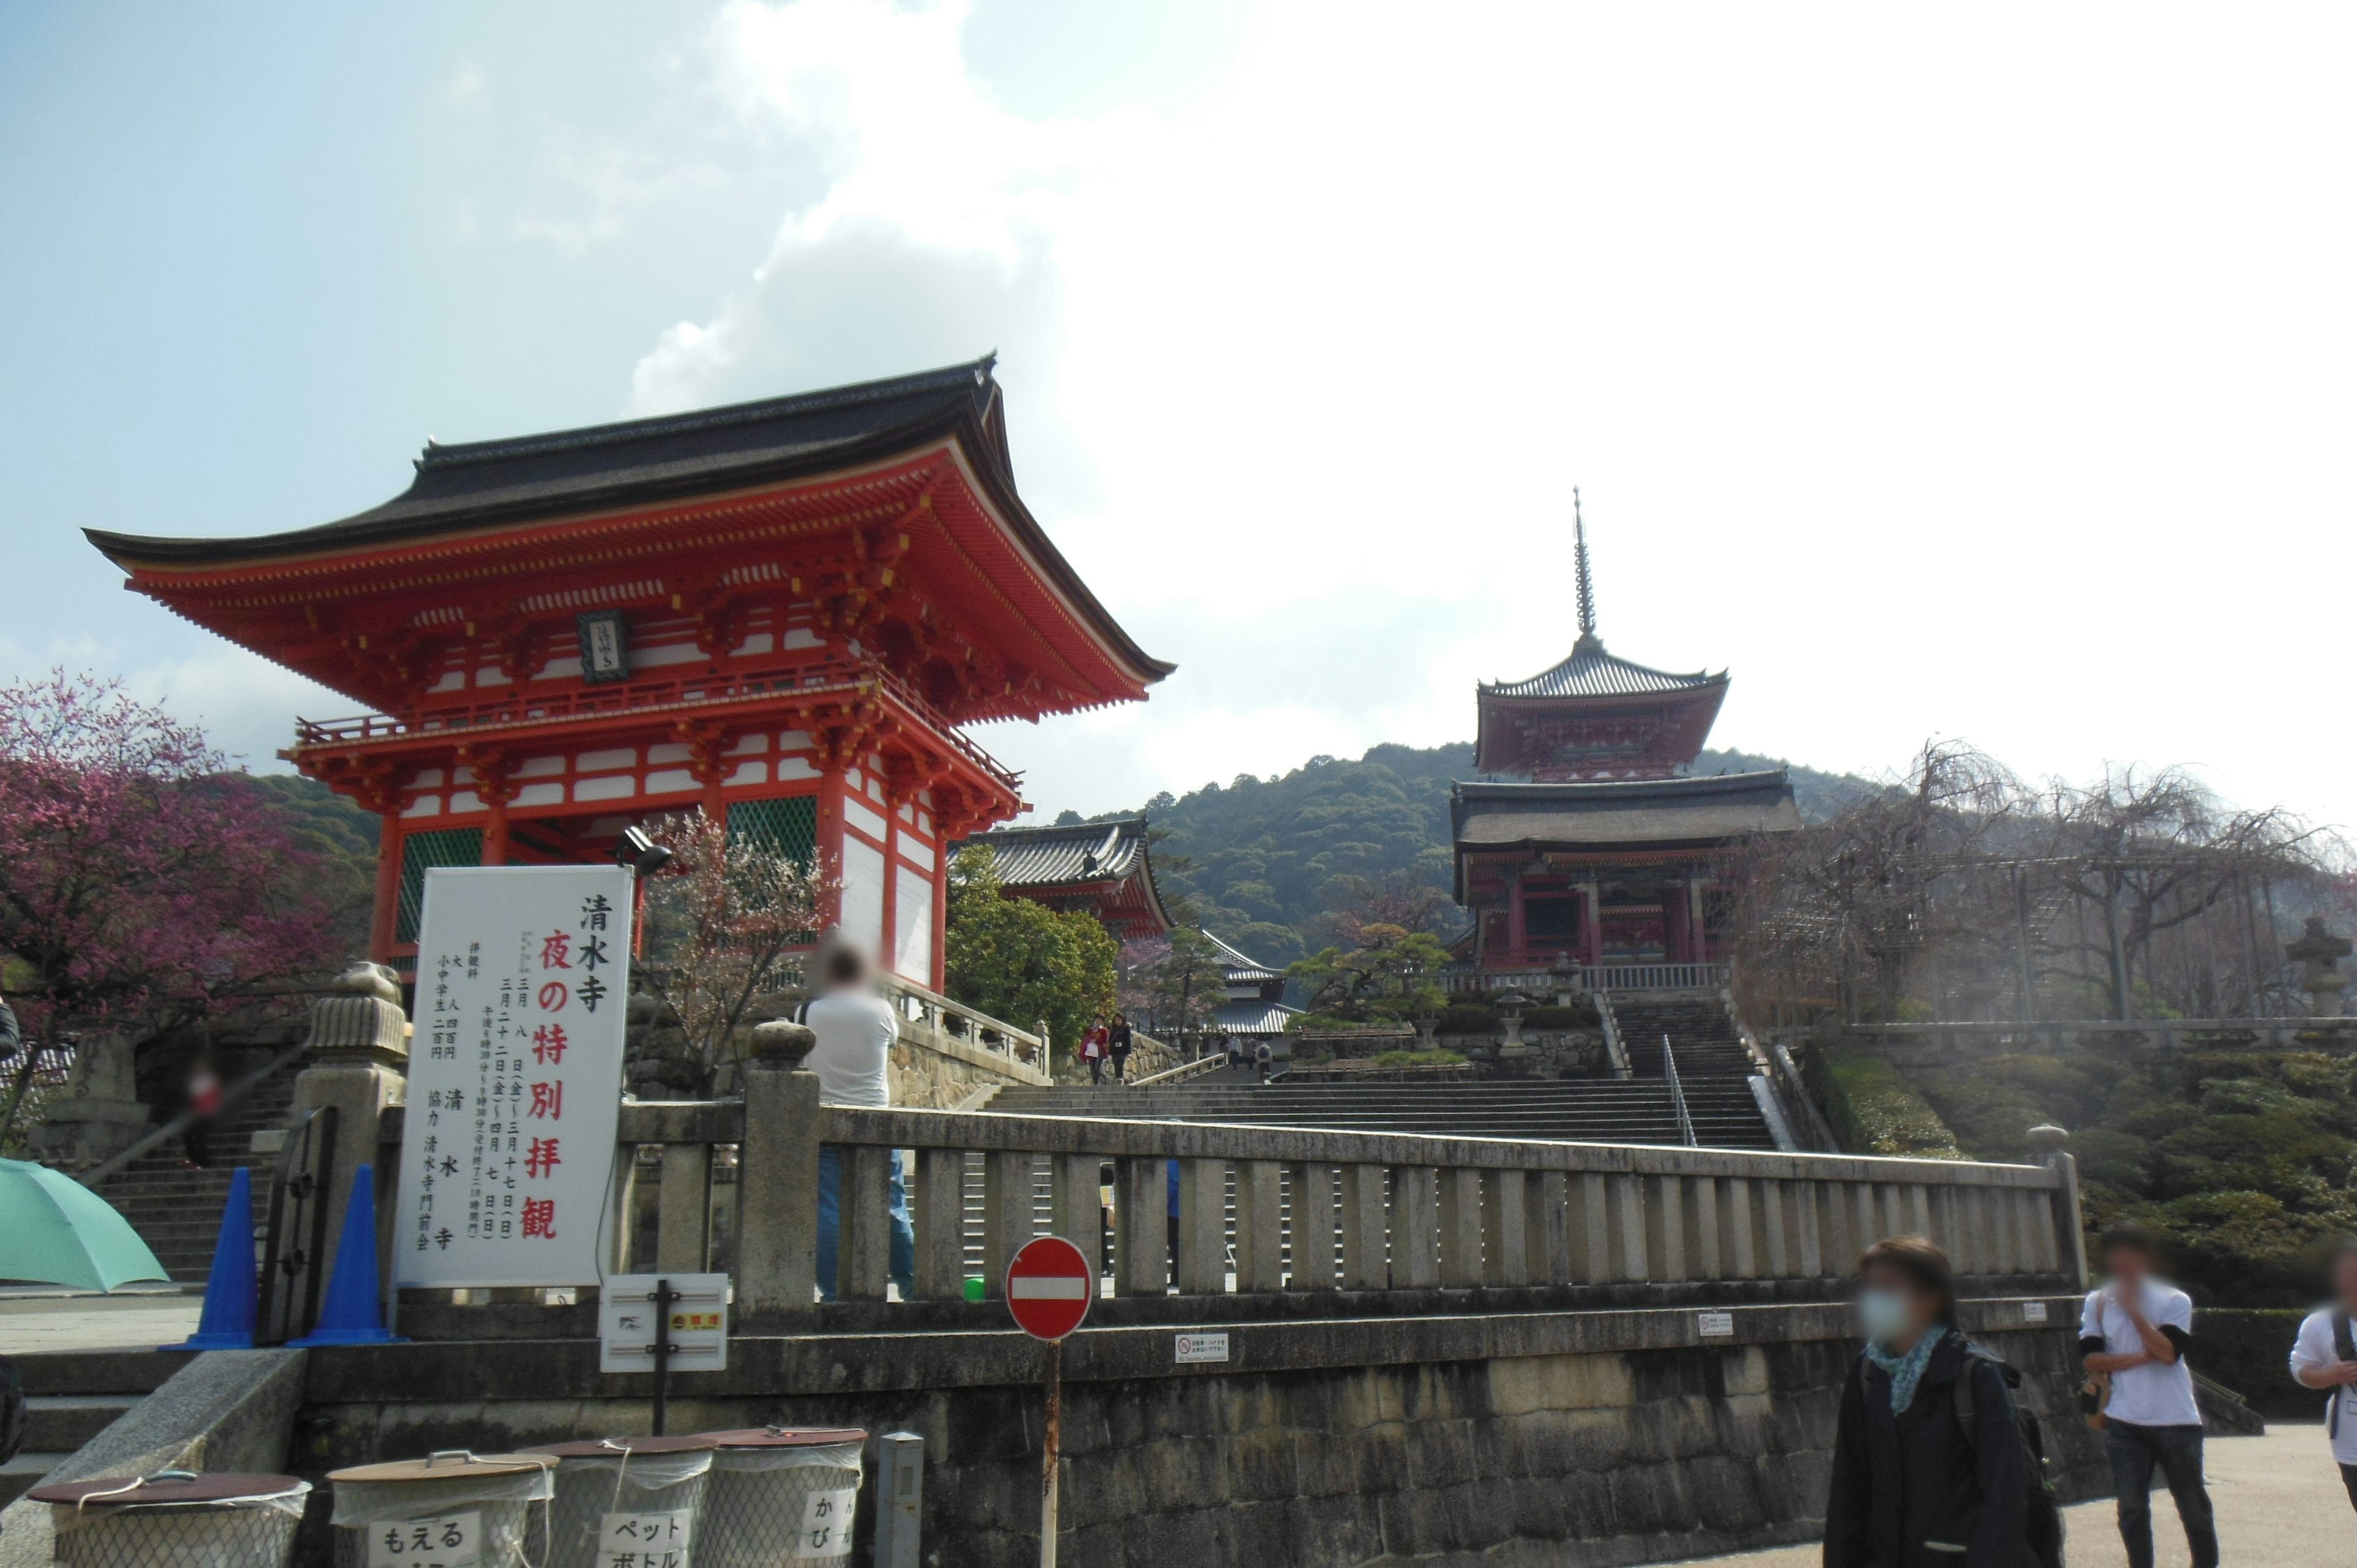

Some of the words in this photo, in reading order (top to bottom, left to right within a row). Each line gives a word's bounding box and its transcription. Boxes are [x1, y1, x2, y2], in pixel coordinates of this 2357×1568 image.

[576, 894, 613, 1013] 清水寺
[521, 929, 572, 1239] 夜の特別拝観
[435, 1089, 464, 1250] 清水寺
[385, 1522, 462, 1554] もえる
[616, 1518, 679, 1541] ペット
